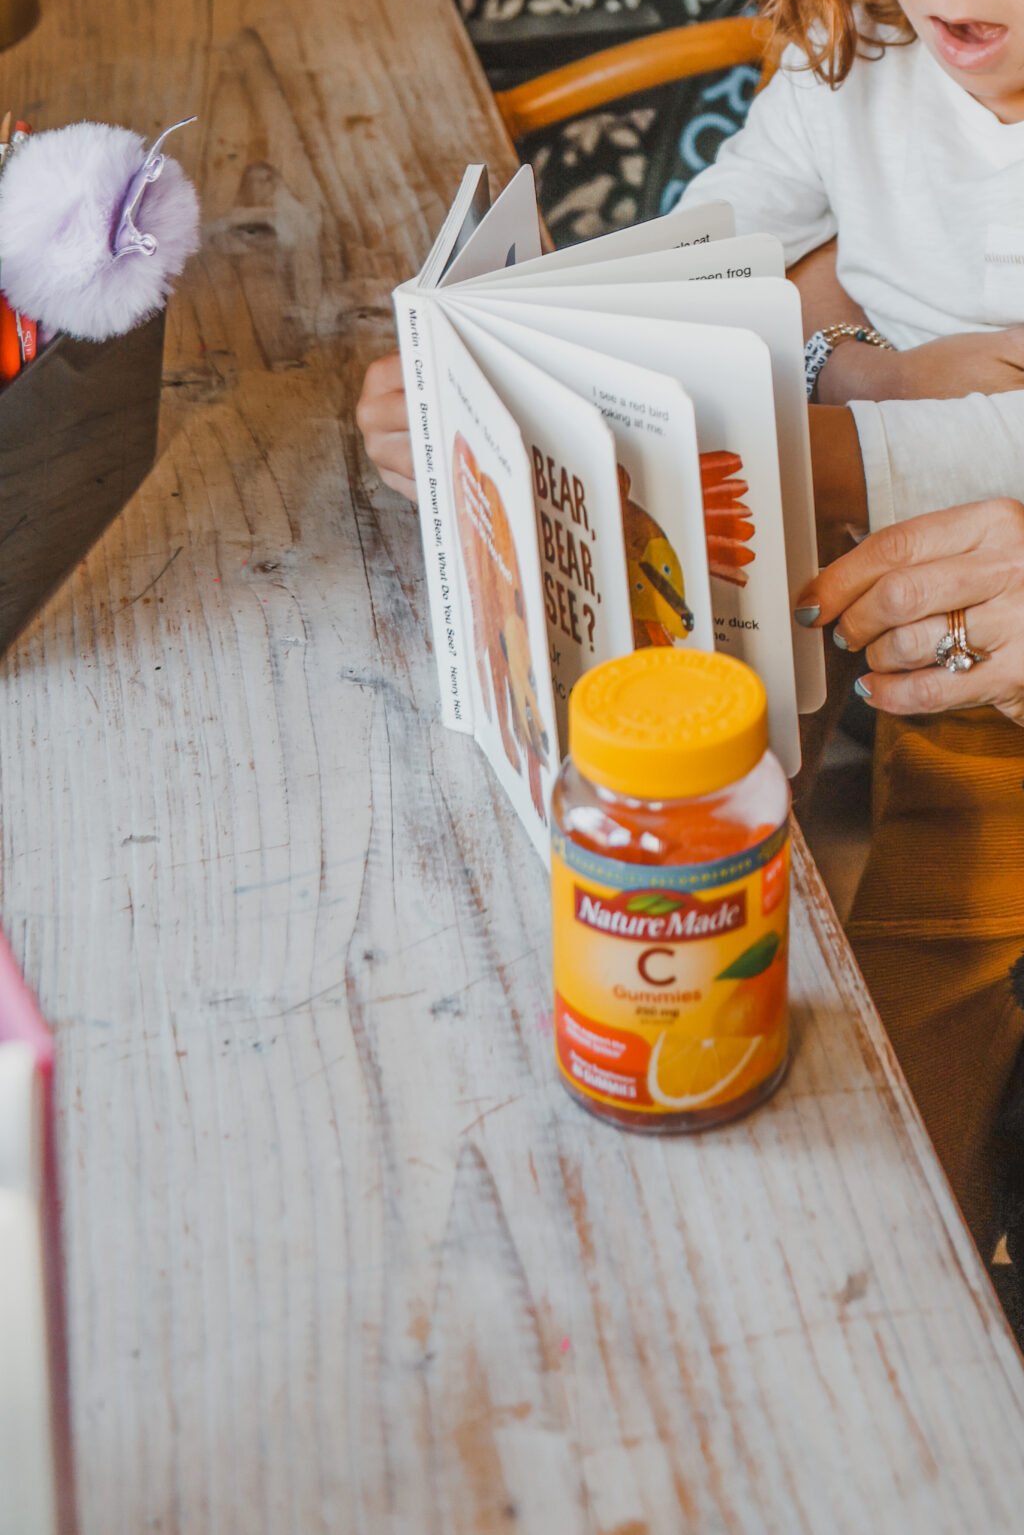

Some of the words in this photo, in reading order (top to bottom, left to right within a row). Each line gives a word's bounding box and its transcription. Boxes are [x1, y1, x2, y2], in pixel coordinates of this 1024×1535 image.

[693, 234, 710, 245] cat
[727, 267, 751, 278] frog
[409, 308, 419, 347] Martin
[414, 359, 424, 391] Carle
[420, 402, 430, 440] Brown
[600, 390, 617, 403] see
[620, 397, 626, 407] a
[629, 401, 646, 414] red
[649, 405, 669, 423] bird
[425, 444, 434, 473] Bear,
[429, 478, 440, 514] Brown
[531, 444, 596, 541] BEAR,
[433, 519, 442, 547] Bear,
[438, 551, 448, 581] What
[540, 511, 601, 604] BEAR,
[441, 584, 449, 600] Do
[443, 604, 452, 629] You
[543, 571, 596, 653] SEE?
[729, 617, 759, 630] duck
[446, 627, 457, 657] See?
[450, 666, 460, 695] Henry
[453, 695, 462, 720] Holt
[579, 896, 665, 938] Nature
[665, 903, 740, 938] Made
[637, 947, 676, 986] C
[613, 984, 701, 1003] Gummies
